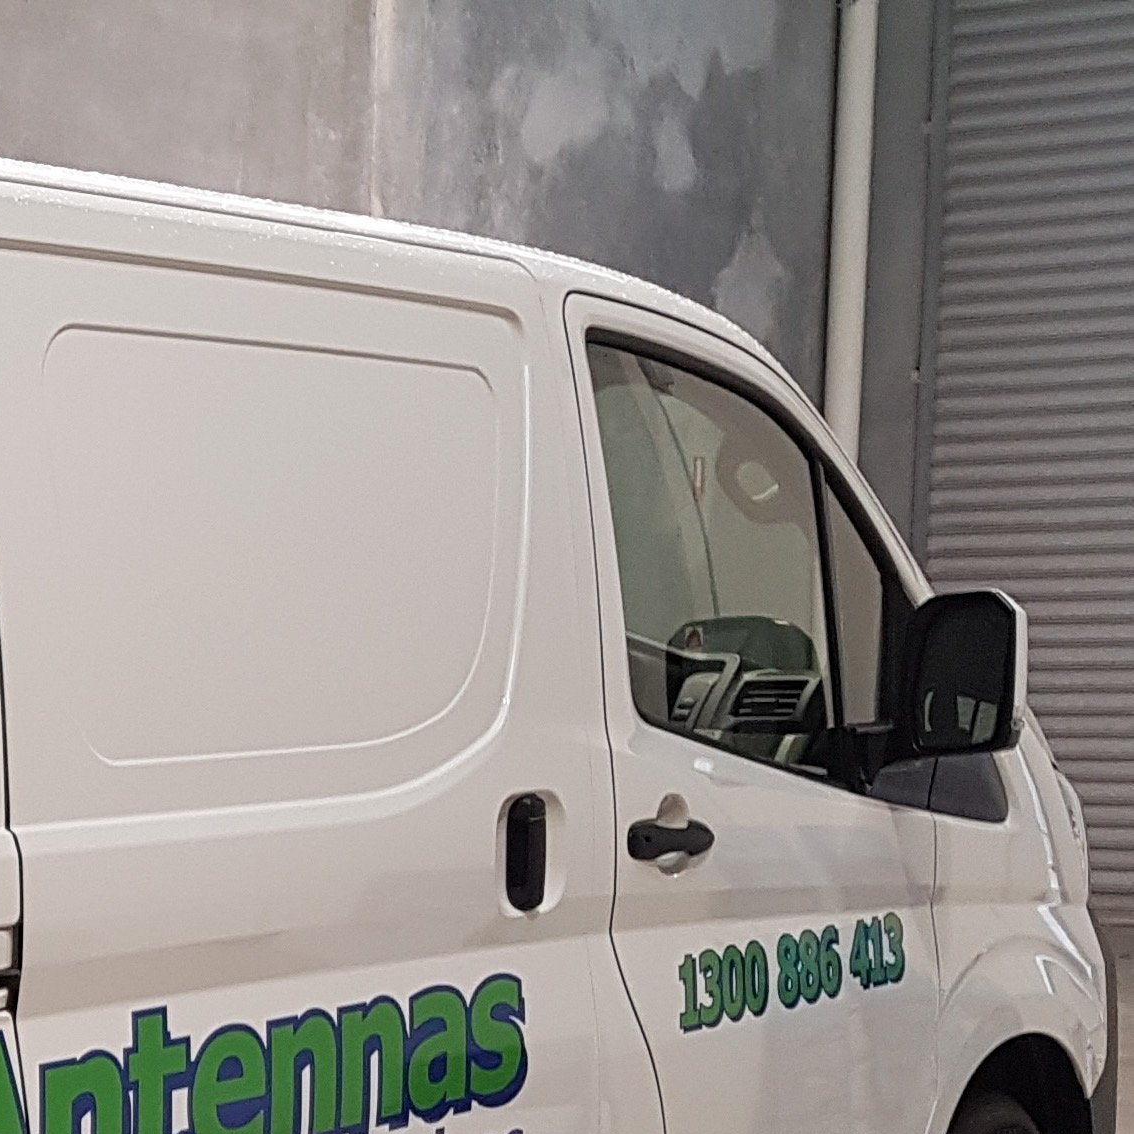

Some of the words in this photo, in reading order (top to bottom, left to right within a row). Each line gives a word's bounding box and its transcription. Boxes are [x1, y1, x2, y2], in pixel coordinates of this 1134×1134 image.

[678, 939, 769, 1034] 1300
[776, 924, 843, 1010] 886
[849, 912, 906, 991] 413
